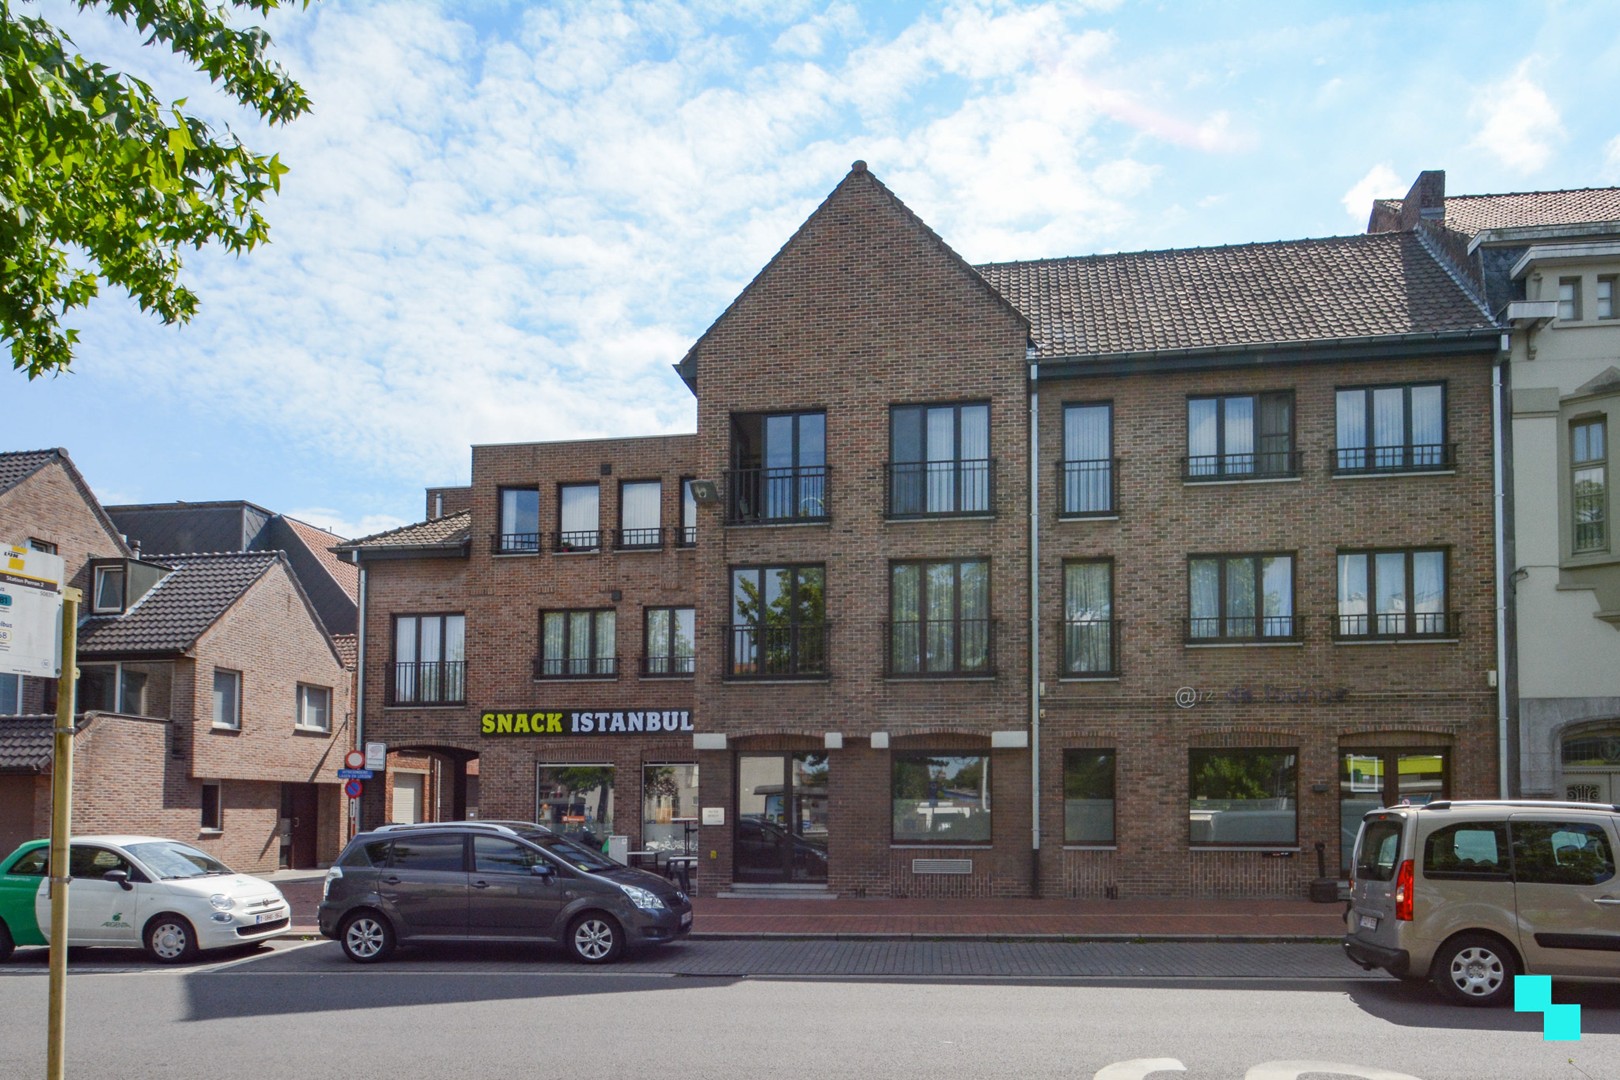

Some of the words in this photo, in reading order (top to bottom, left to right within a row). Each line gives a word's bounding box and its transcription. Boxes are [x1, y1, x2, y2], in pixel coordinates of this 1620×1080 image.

[0, 621, 12, 629] lbus
[481, 713, 563, 733] SNACK
[571, 711, 694, 731] ISTANBUL
